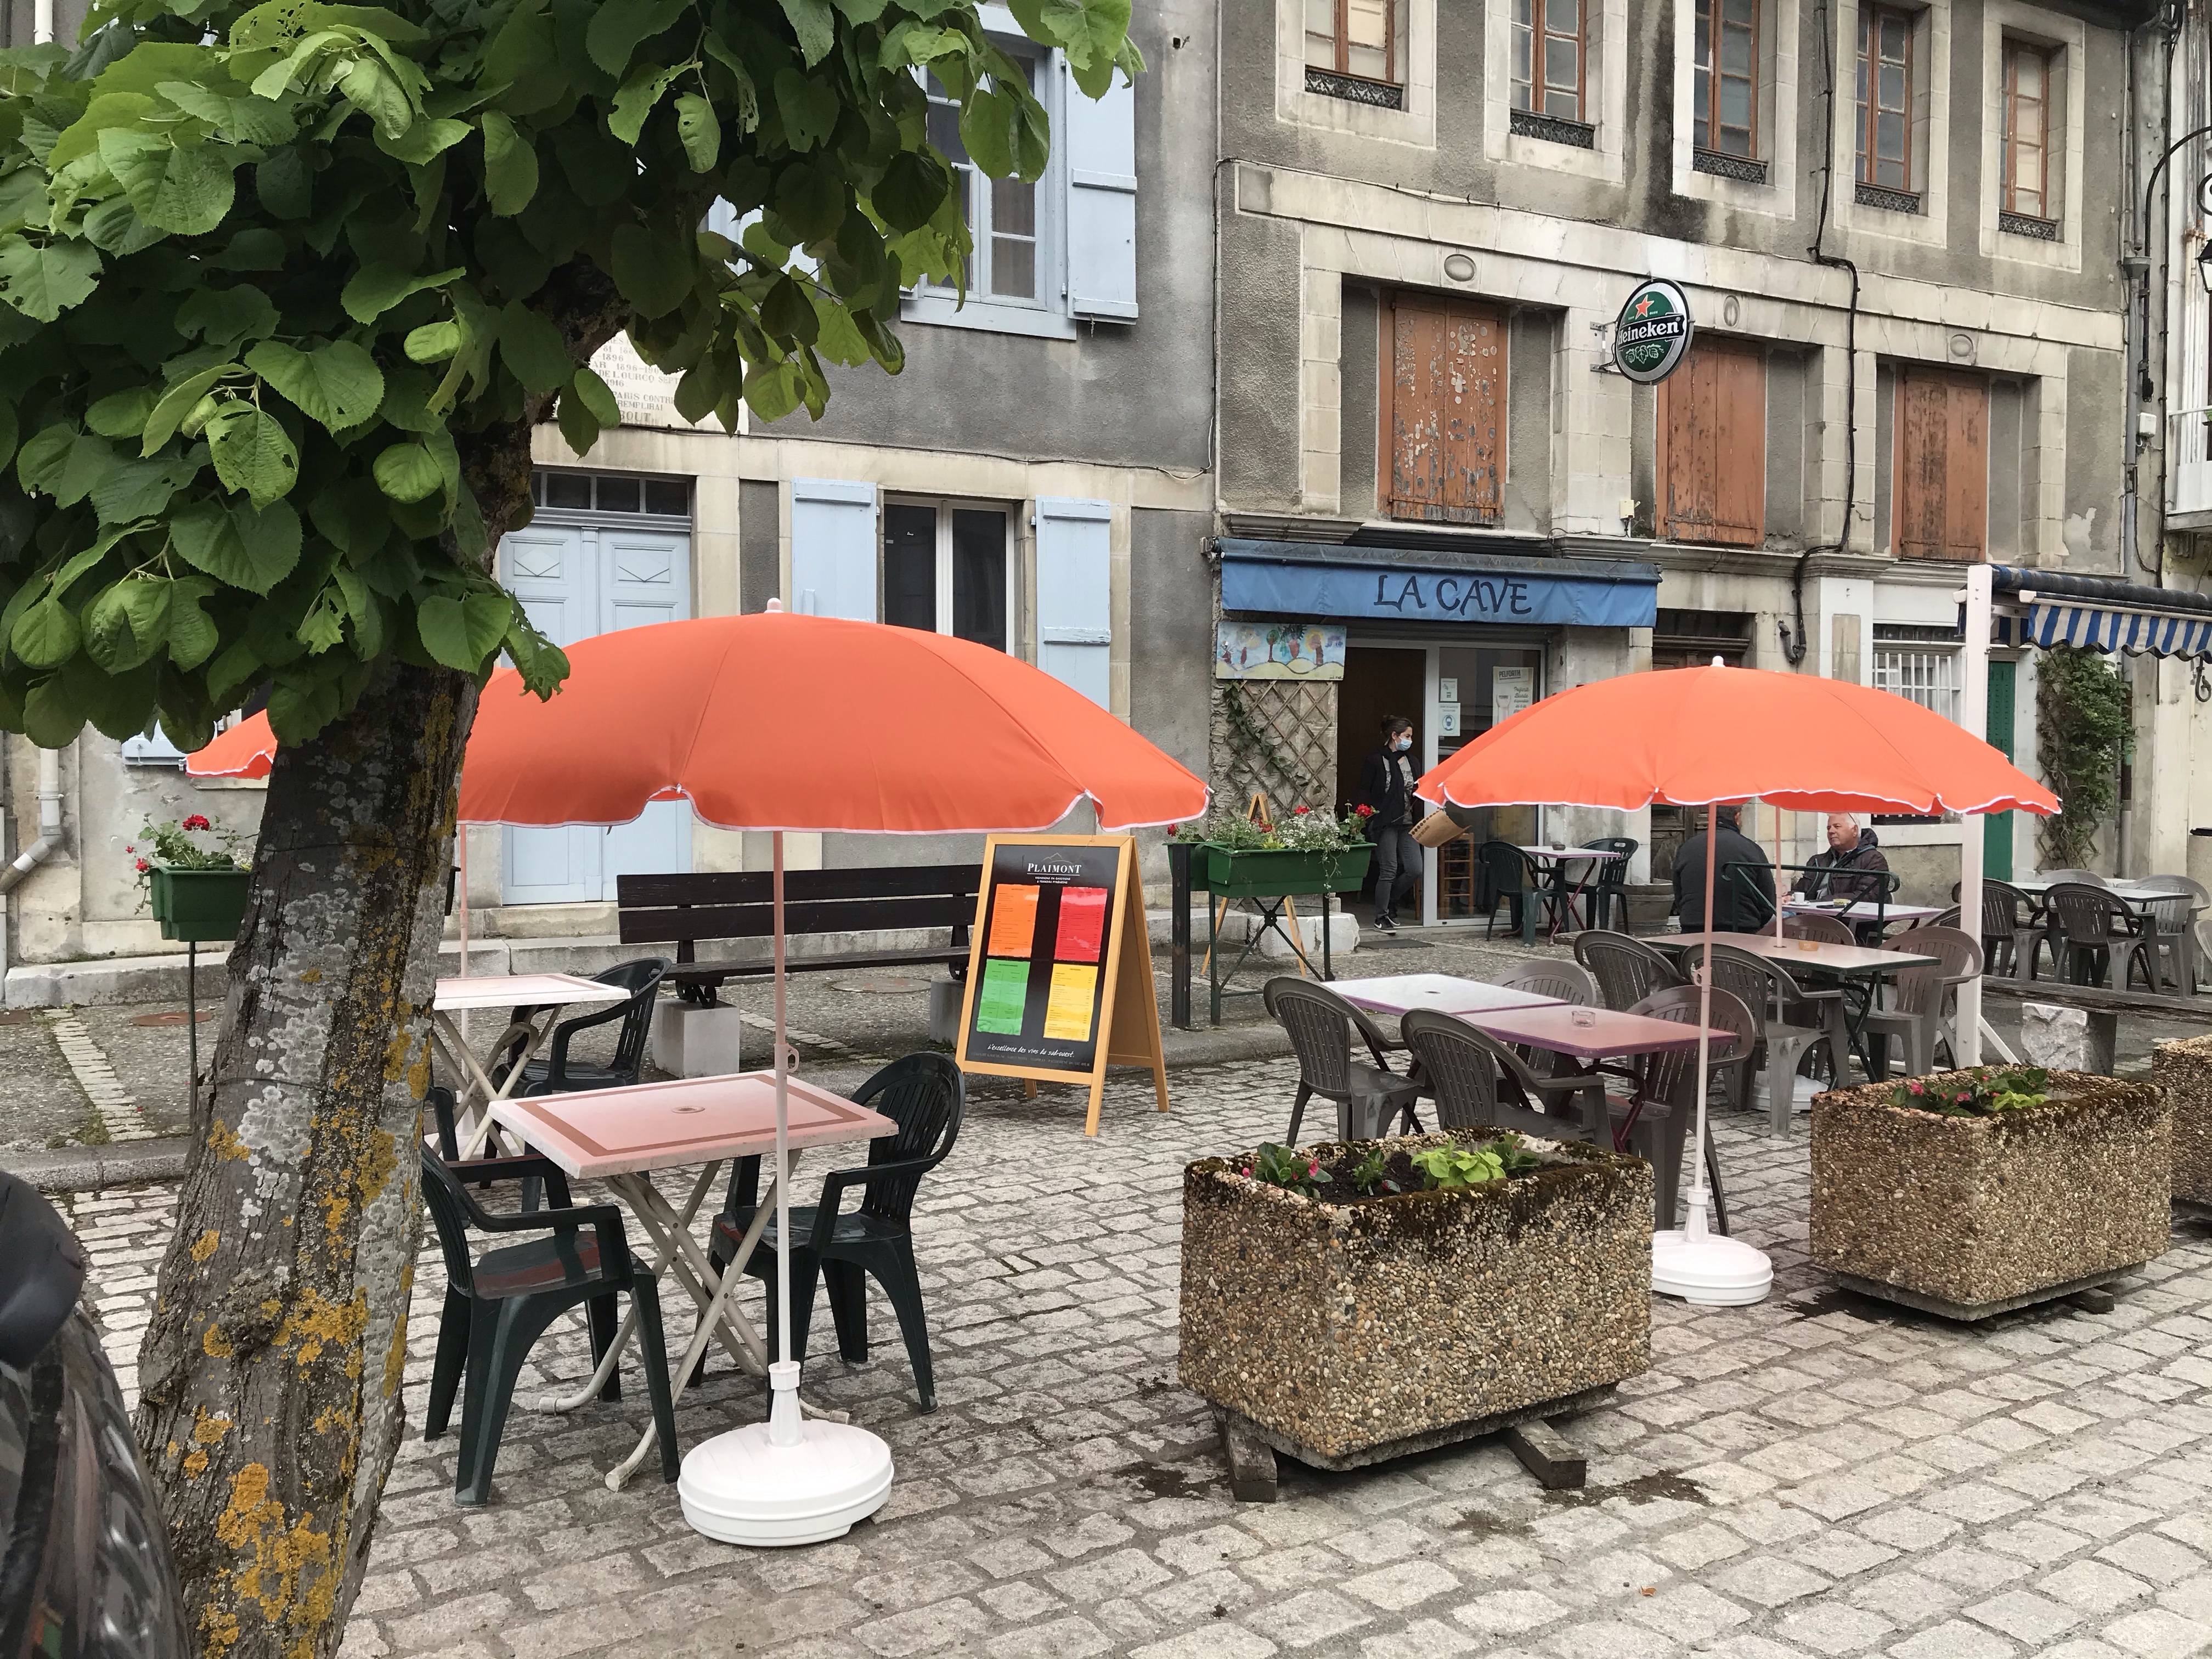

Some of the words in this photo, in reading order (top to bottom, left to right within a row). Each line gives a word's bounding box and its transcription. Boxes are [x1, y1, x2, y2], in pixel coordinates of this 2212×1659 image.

[1618, 321, 1679, 346] Heineken
[1373, 574, 1426, 612] LA
[1436, 578, 1532, 616] CAVE
[1498, 669, 1521, 678] PELFORTH
[1027, 863, 1082, 873] PLAIMONT
[988, 1043, 1017, 1053] L'excellence
